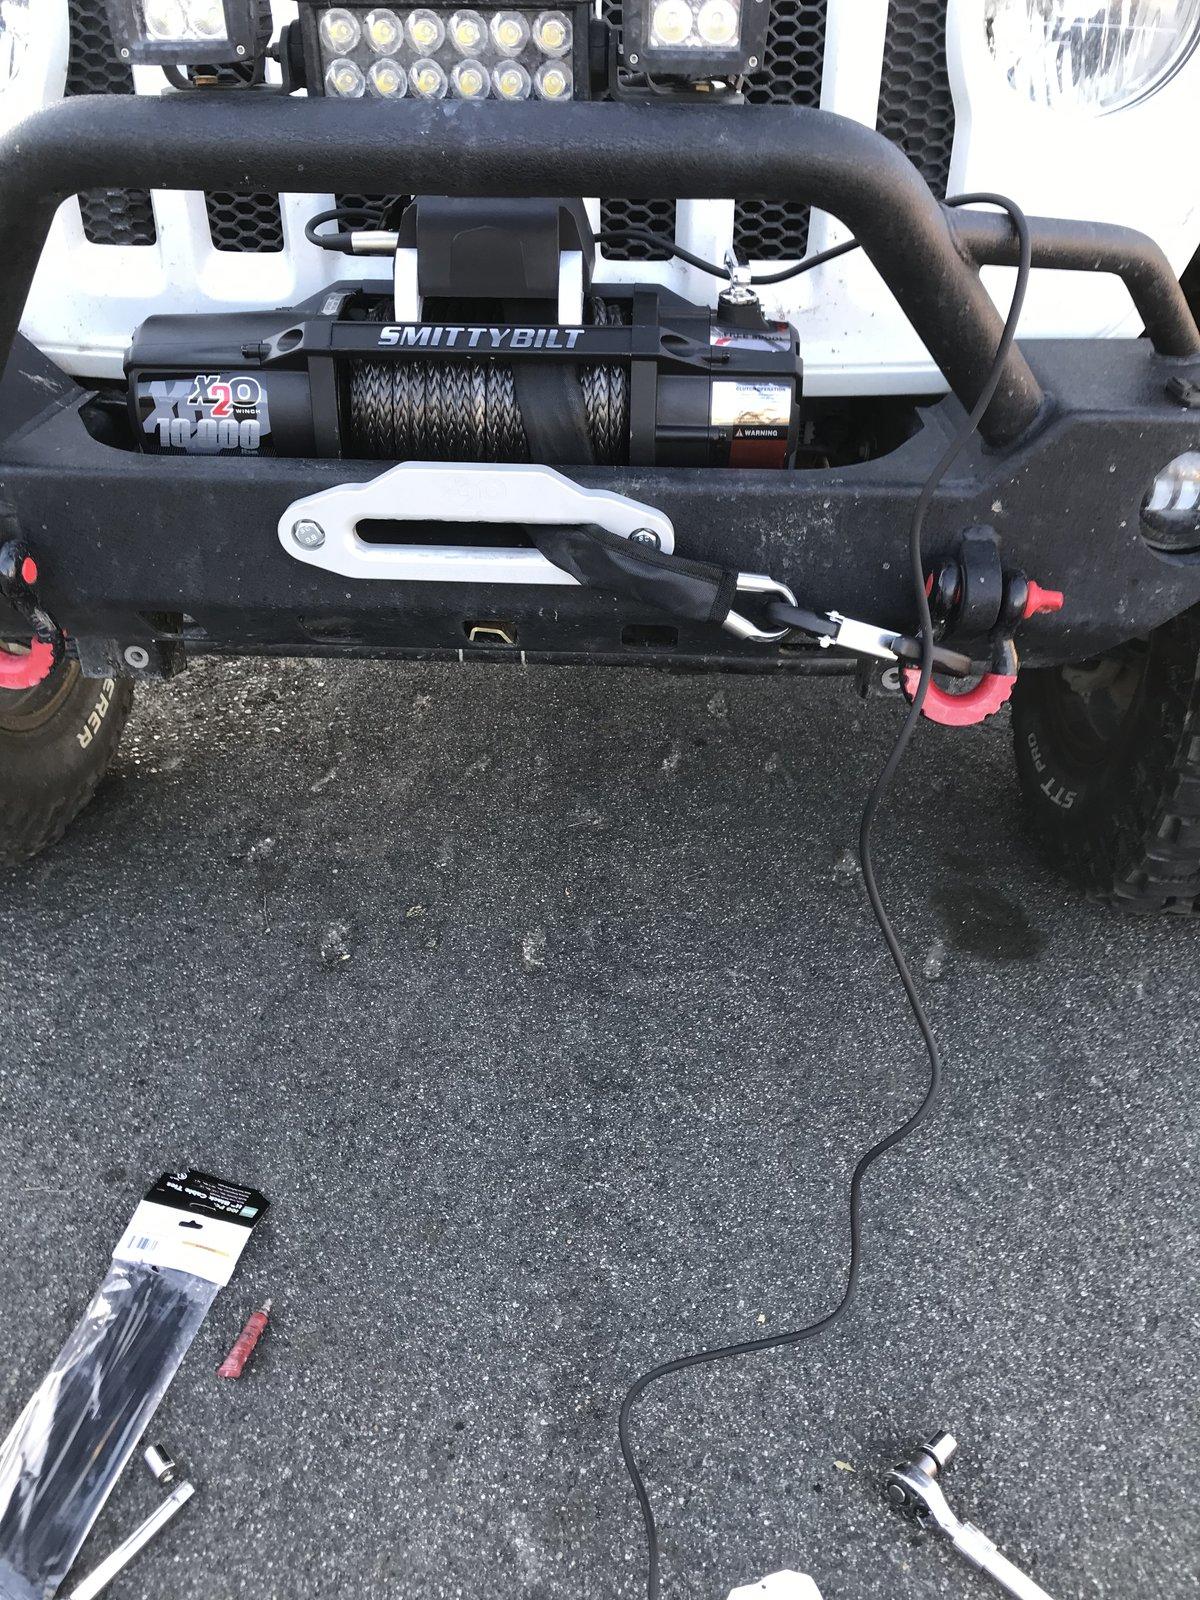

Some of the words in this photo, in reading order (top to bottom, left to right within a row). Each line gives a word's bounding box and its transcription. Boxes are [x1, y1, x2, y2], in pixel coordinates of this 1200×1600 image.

[378, 326, 585, 348] SMITTYBILT
[744, 429, 778, 437] WARNING
[1028, 732, 1046, 773] PRO
[1040, 777, 1077, 809] STT
[166, 1181, 183, 1192] Ties
[184, 1188, 208, 1199] Cable
